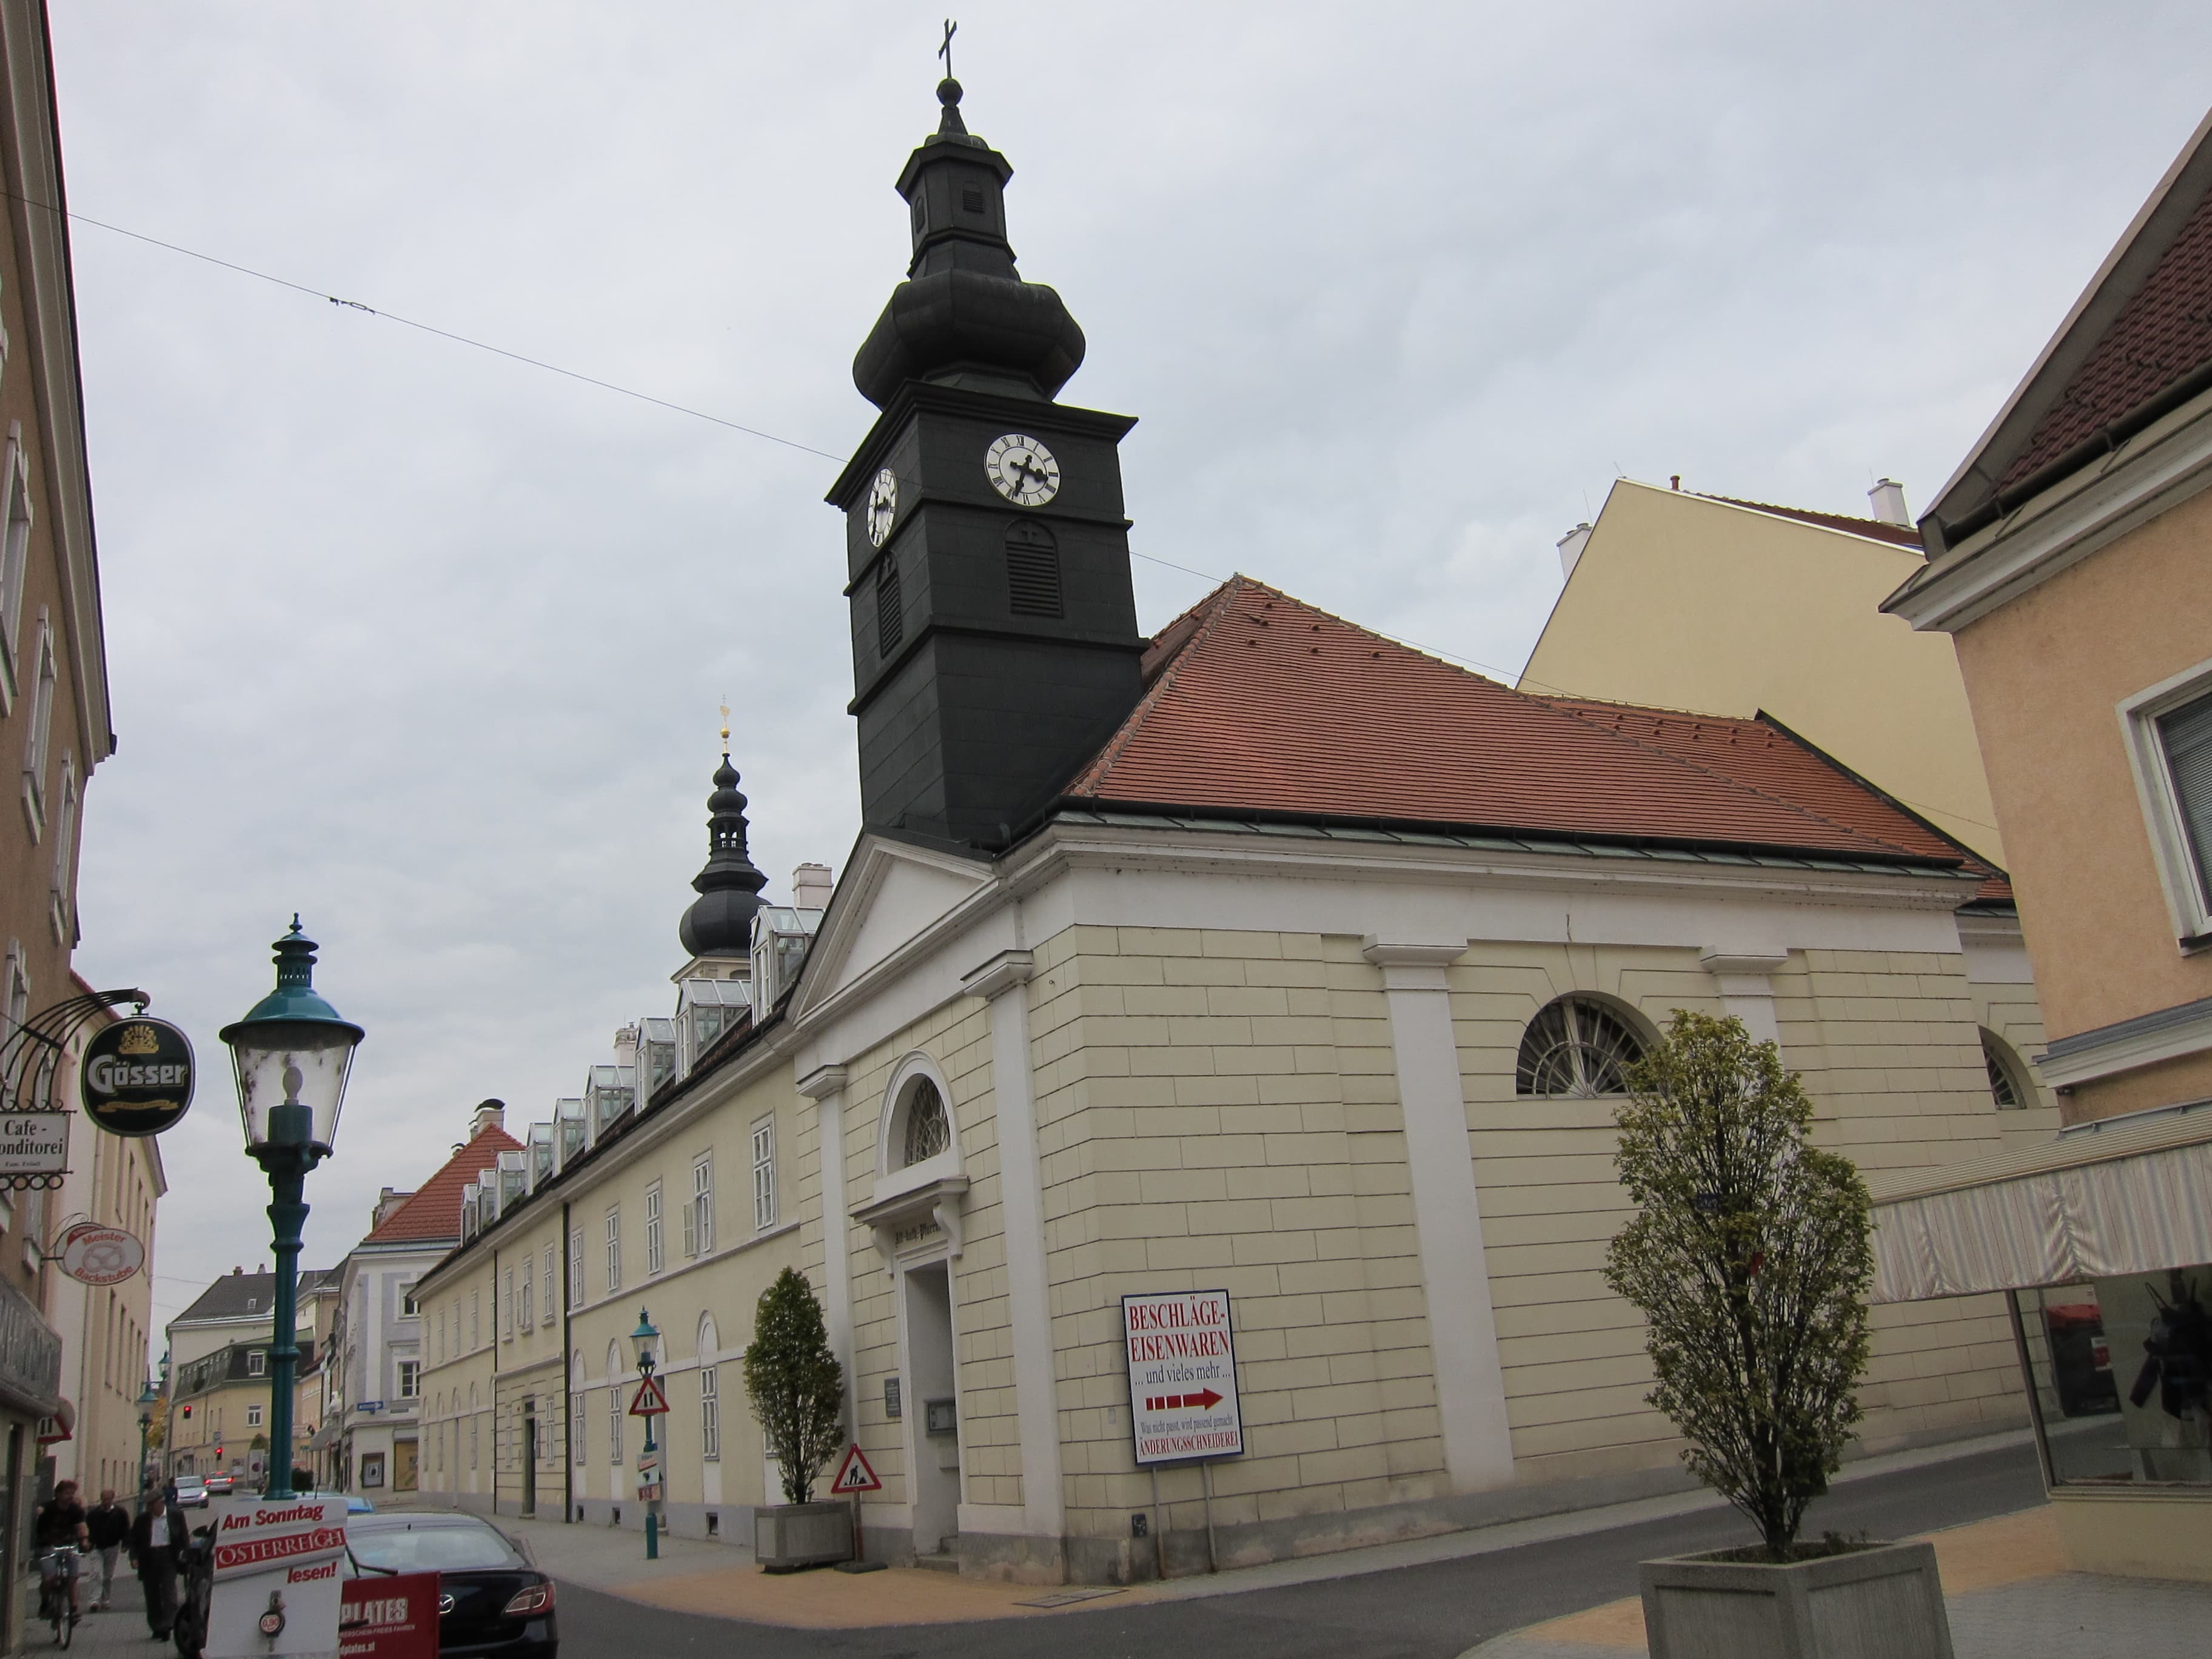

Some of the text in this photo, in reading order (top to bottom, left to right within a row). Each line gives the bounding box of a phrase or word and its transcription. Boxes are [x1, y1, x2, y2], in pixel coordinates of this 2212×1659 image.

[88, 1054, 189, 1096] Gösser
[5, 1119, 37, 1136] Cafe
[0, 1138, 62, 1155] onditorei
[82, 1232, 126, 1246] Meister
[75, 1266, 133, 1283] Backstube
[1129, 1295, 1225, 1331] BESCHLÄGE-
[1130, 1330, 1229, 1362] EISENWAREN
[1146, 1365, 1164, 1384] und
[1167, 1363, 1194, 1382] vieles
[1197, 1361, 1220, 1379] mehr
[1141, 1422, 1152, 1433] Was
[1139, 1431, 1238, 1455] ÄNDERUNGSSCHNEIDEREI
[221, 1504, 324, 1531] Am Sonntag
[219, 1530, 342, 1565] ÖSTERREICH
[286, 1562, 337, 1584] lesen!
[340, 1641, 375, 1656] dplates.at
